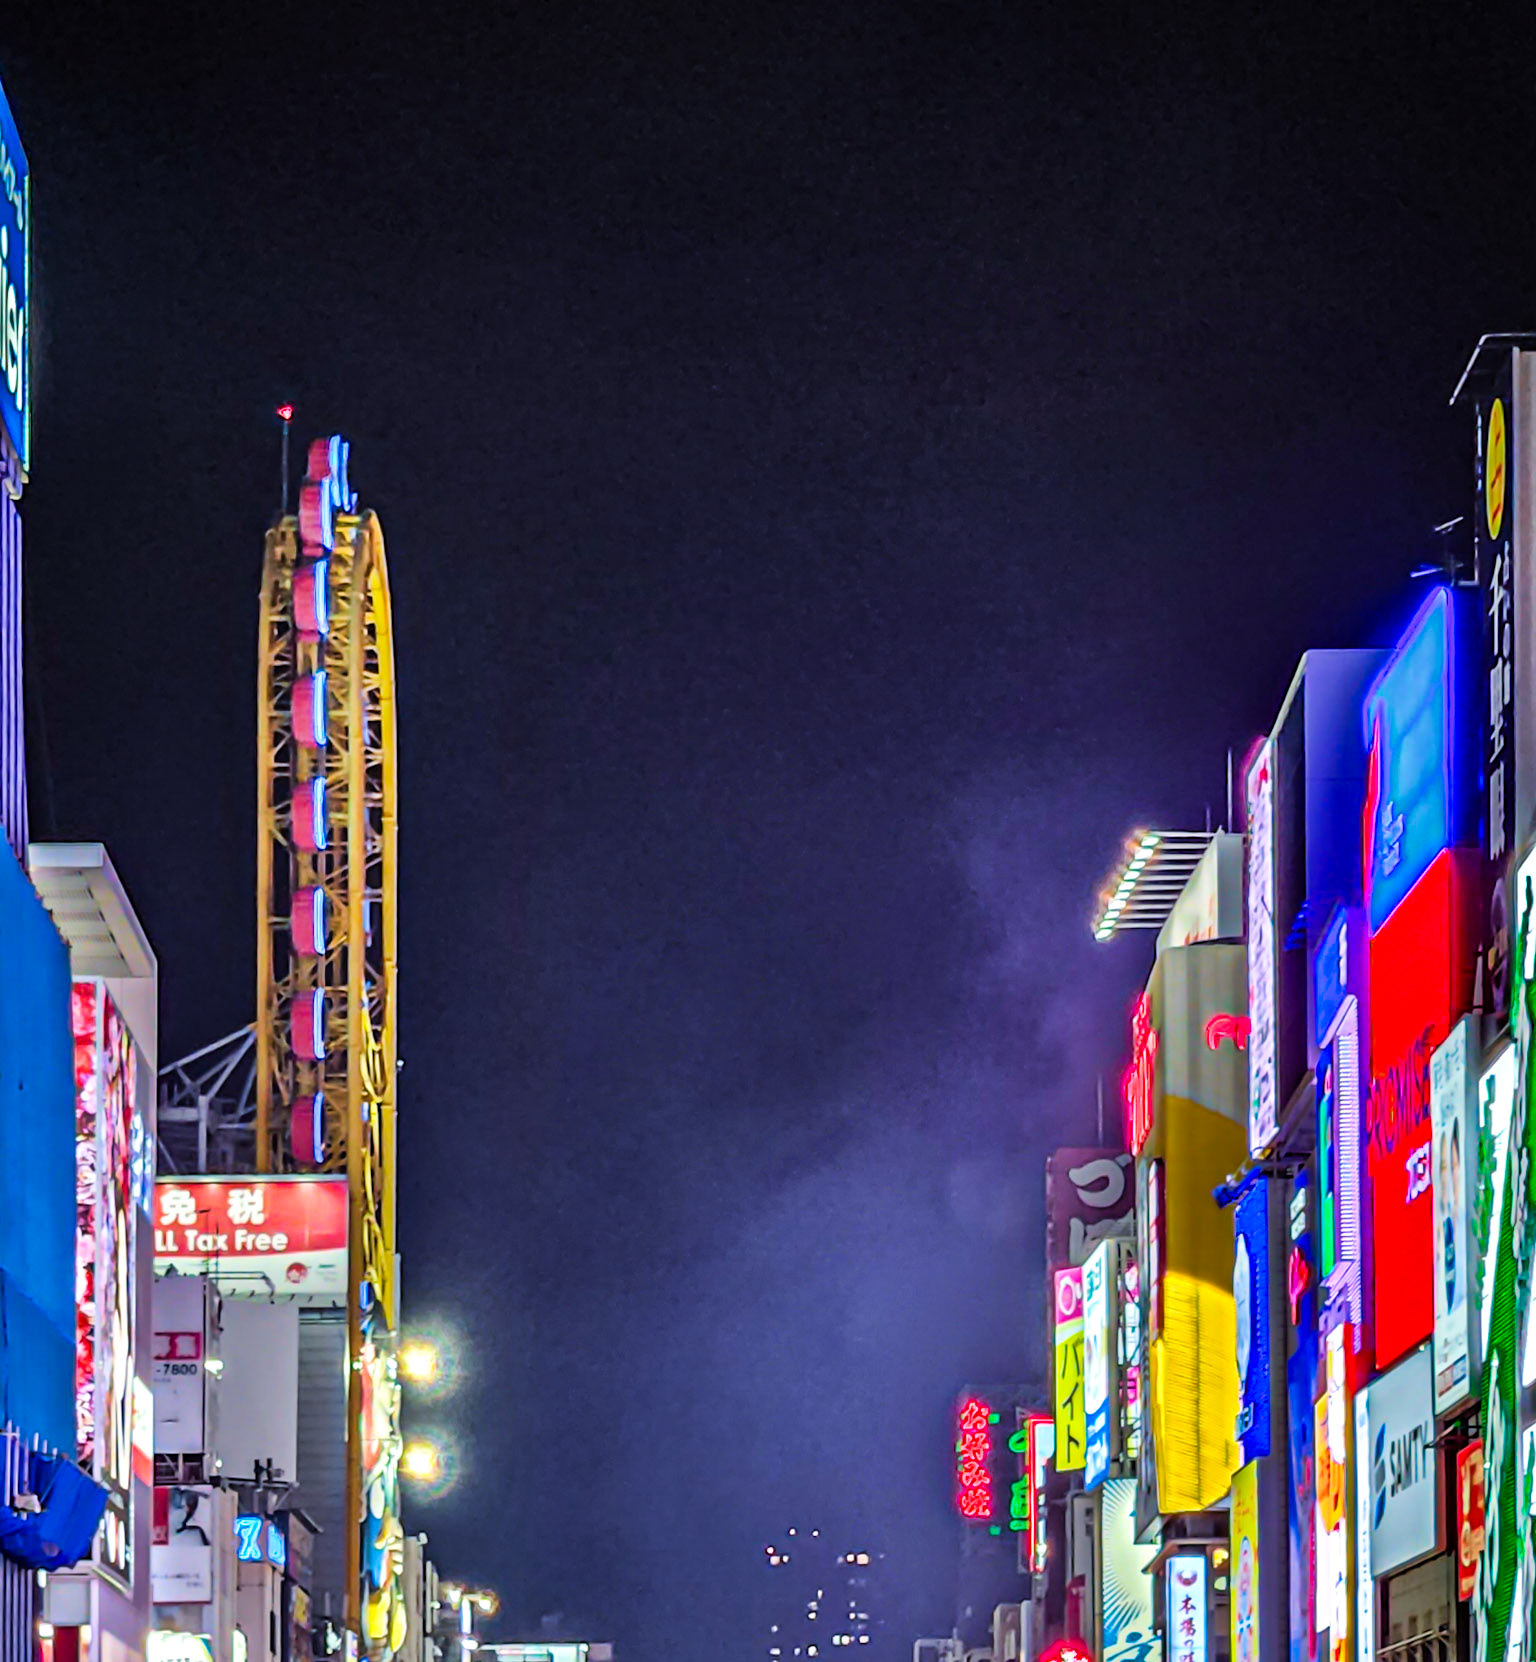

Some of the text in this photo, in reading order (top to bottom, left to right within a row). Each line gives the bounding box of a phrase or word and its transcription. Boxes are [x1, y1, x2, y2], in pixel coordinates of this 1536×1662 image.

[160, 1188, 264, 1226] 免税
[184, 1229, 229, 1252] Tax
[234, 1229, 289, 1252] Free
